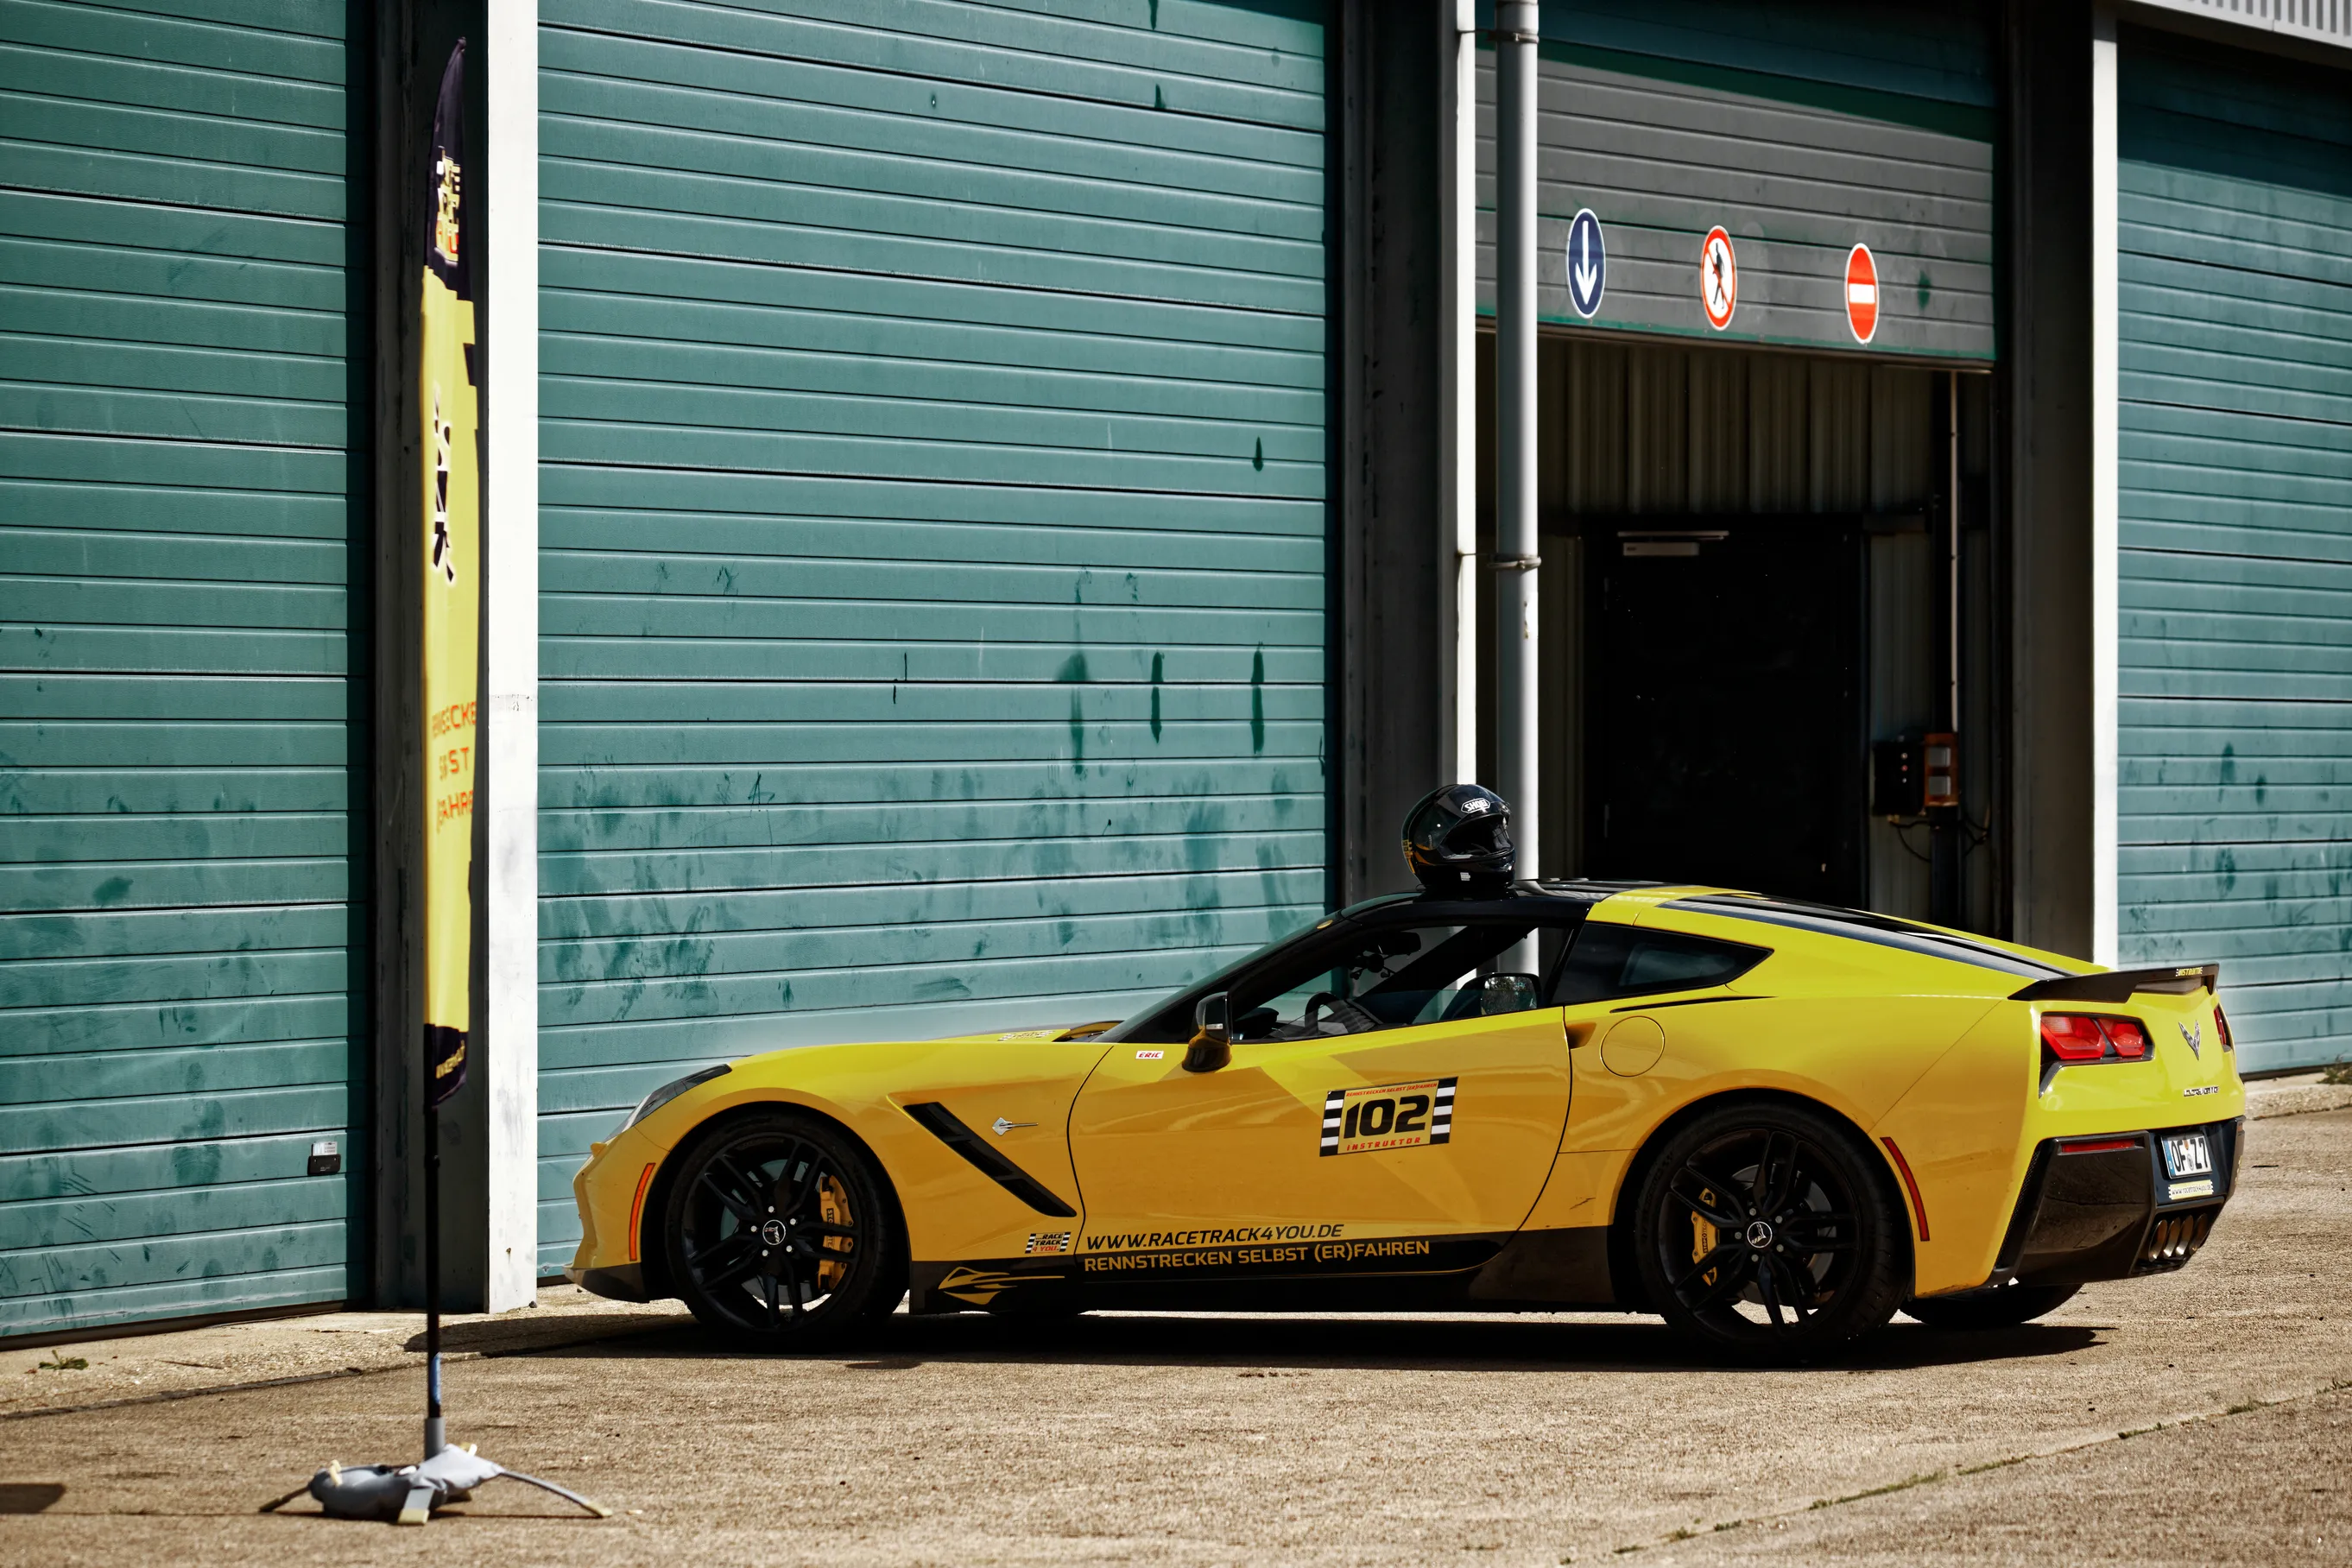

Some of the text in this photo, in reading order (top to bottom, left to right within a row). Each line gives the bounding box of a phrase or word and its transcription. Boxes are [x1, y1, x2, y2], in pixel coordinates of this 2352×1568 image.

[1344, 1094, 1430, 1139] 102
[1346, 1136, 1421, 1151] INSTRUKTOR
[1086, 1223, 1344, 1250] WWW.RACETRACK4YOU.DE
[1084, 1240, 1430, 1272] RENNSTRECKEN SELBST (ER)FAHREN
